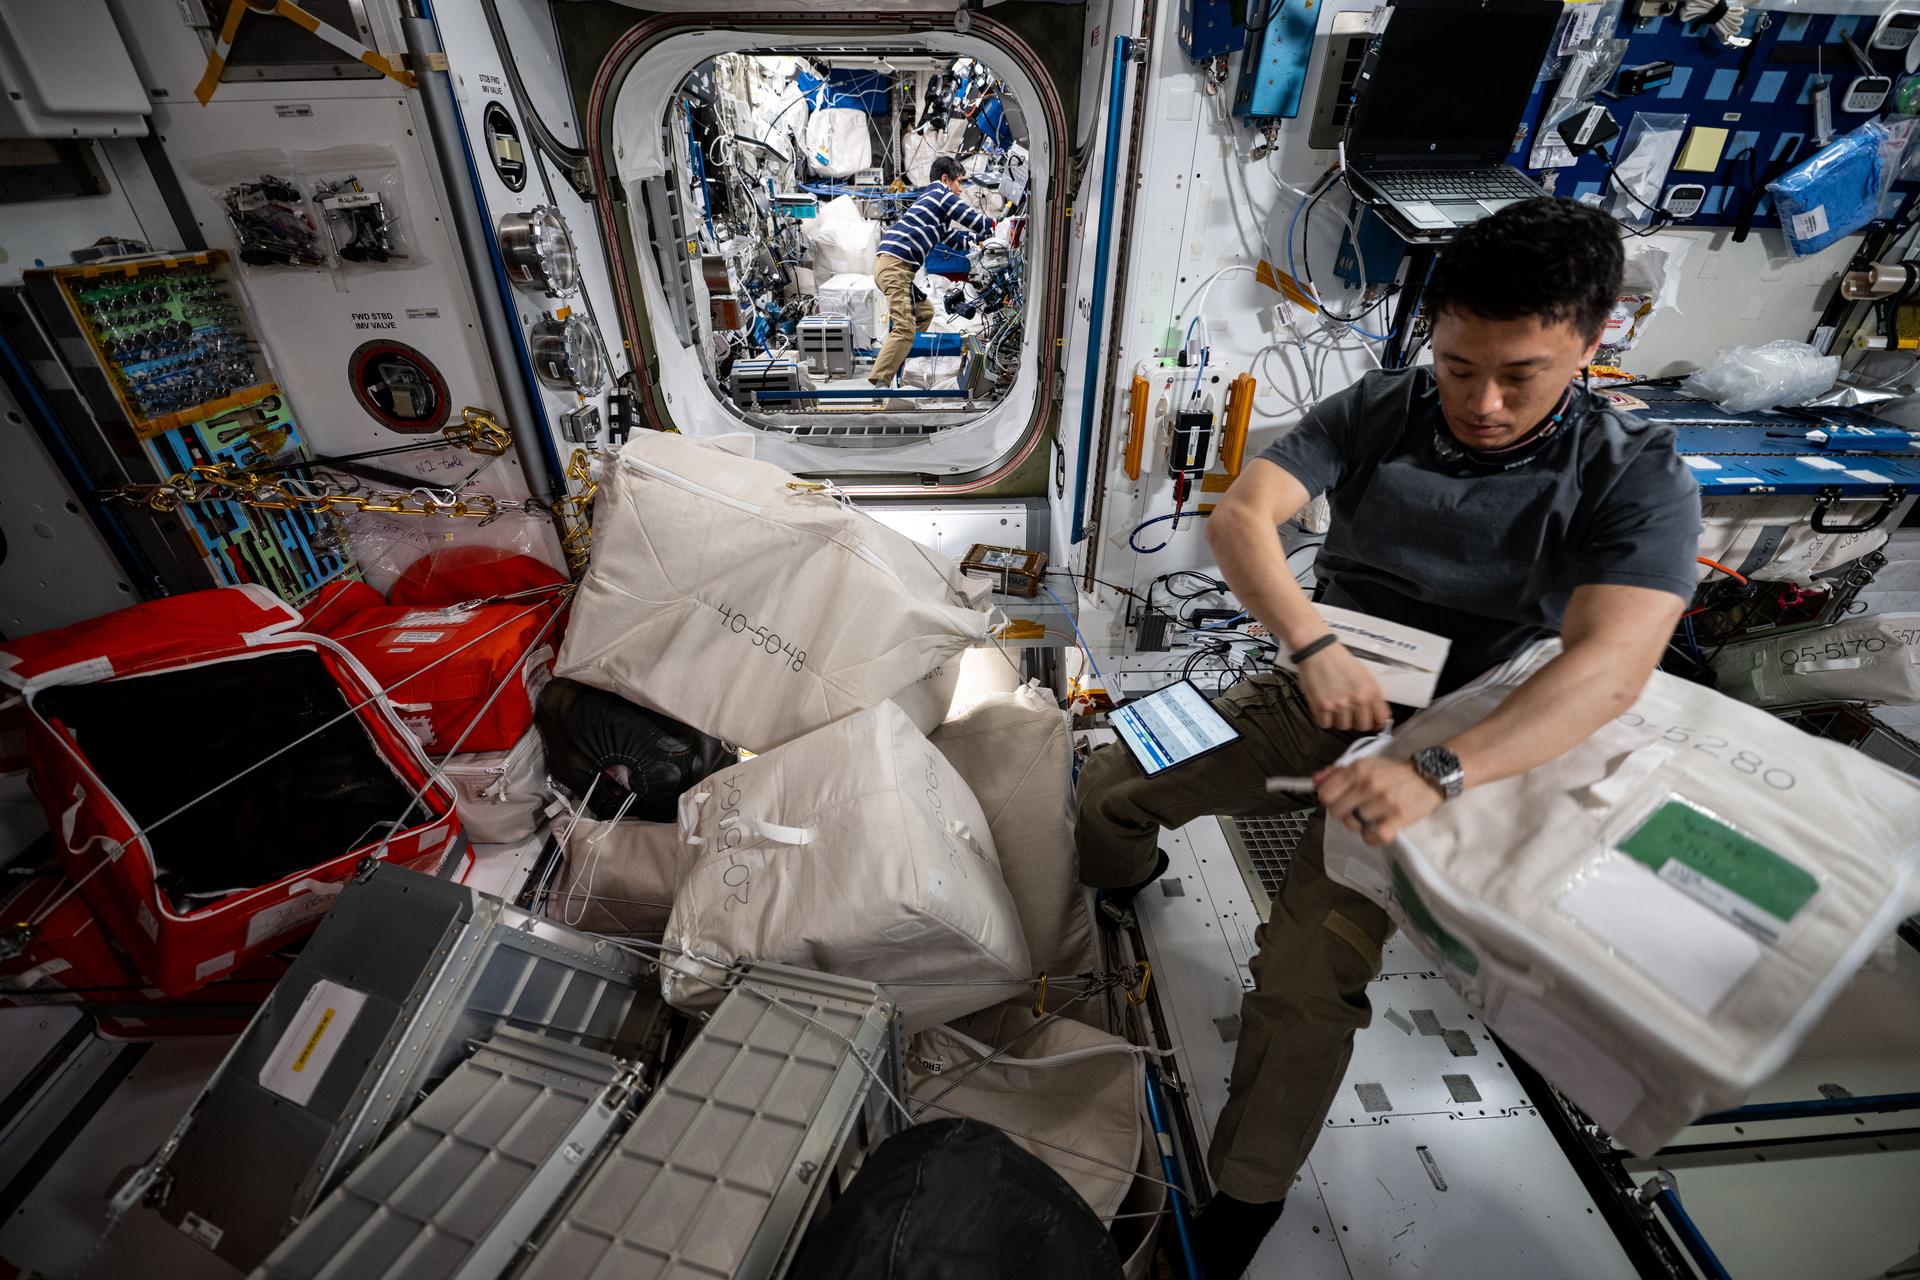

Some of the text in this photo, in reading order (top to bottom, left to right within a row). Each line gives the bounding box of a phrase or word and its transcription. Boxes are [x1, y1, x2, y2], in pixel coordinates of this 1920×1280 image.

[371, 312, 393, 320] STBD
[355, 321, 397, 330] IMV VALVE
[1617, 712, 1796, 791] 0-5280
